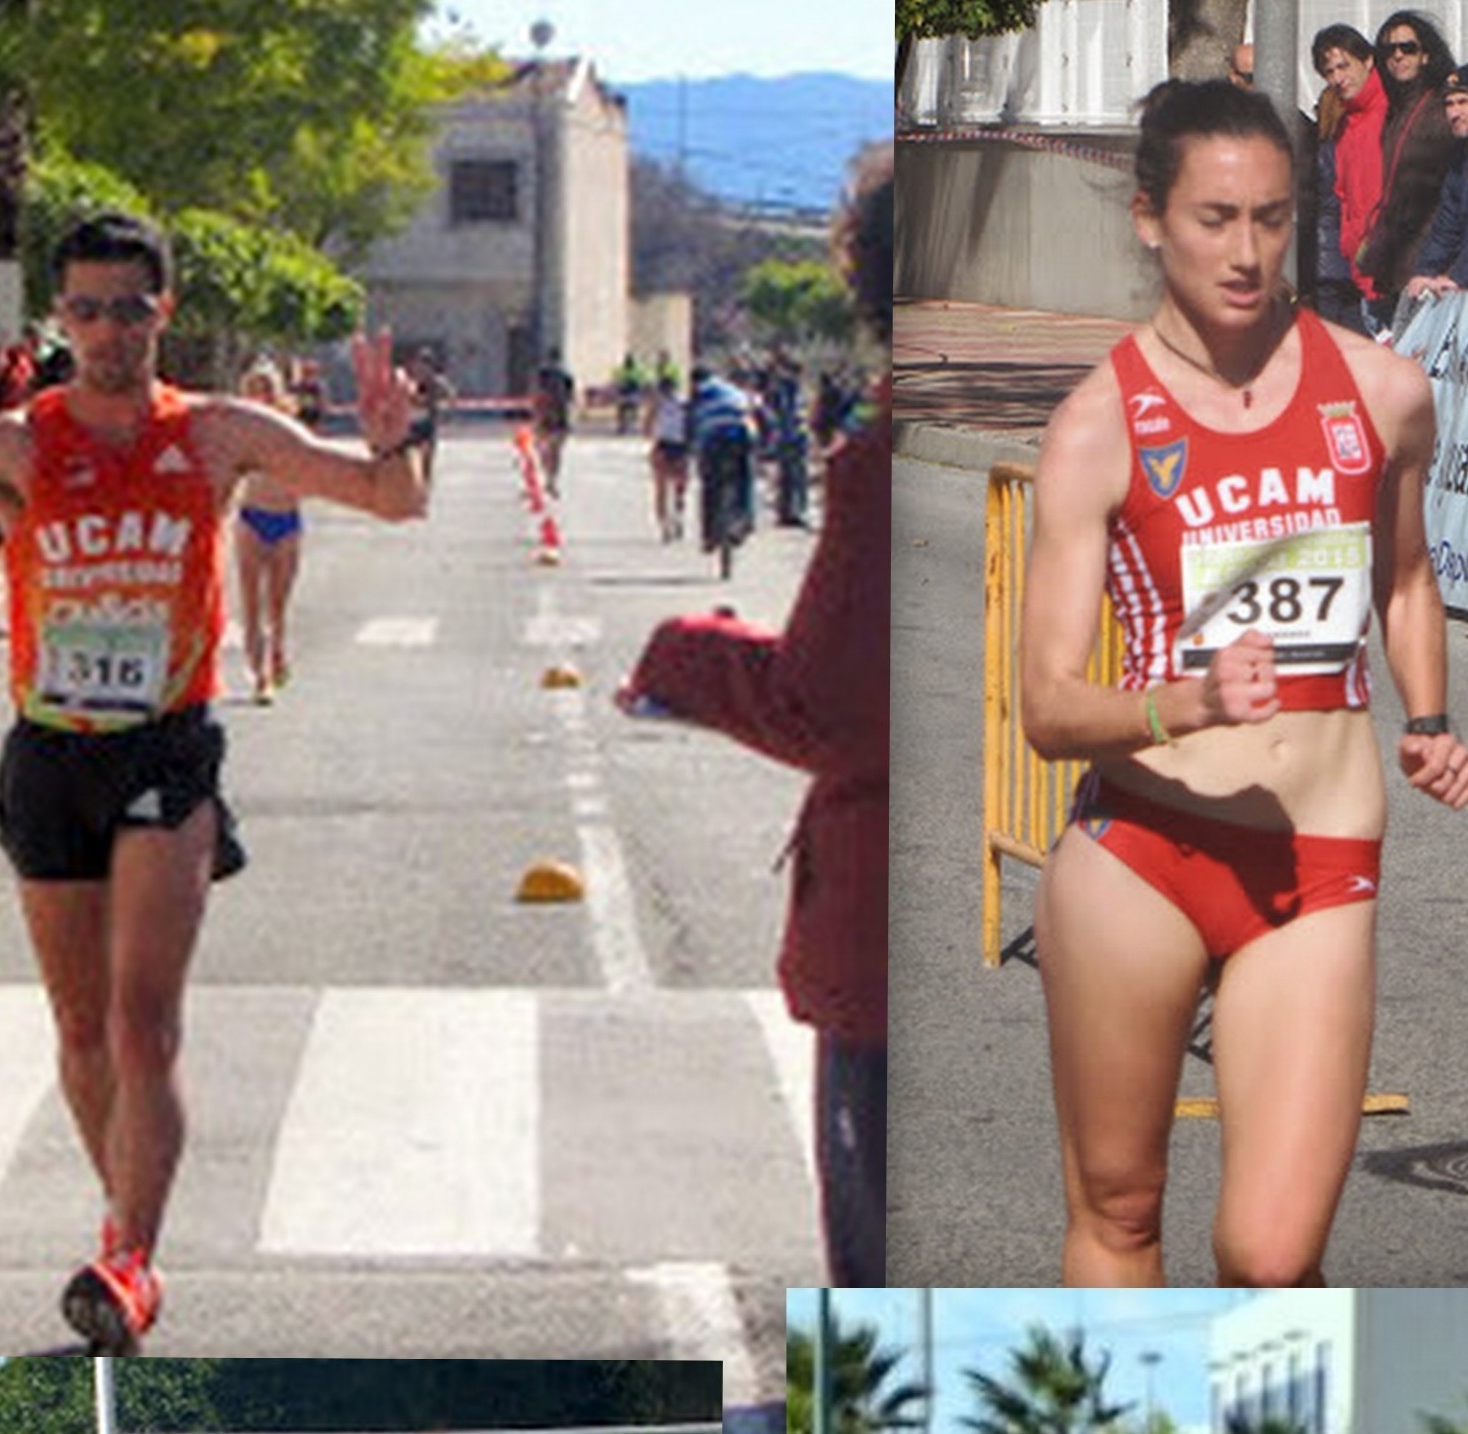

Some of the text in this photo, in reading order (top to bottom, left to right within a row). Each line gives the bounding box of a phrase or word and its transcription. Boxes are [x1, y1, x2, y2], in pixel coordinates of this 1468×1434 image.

[1174, 467, 1336, 528] UCAM
[36, 511, 192, 563] UCAM
[1226, 577, 1345, 625] 387
